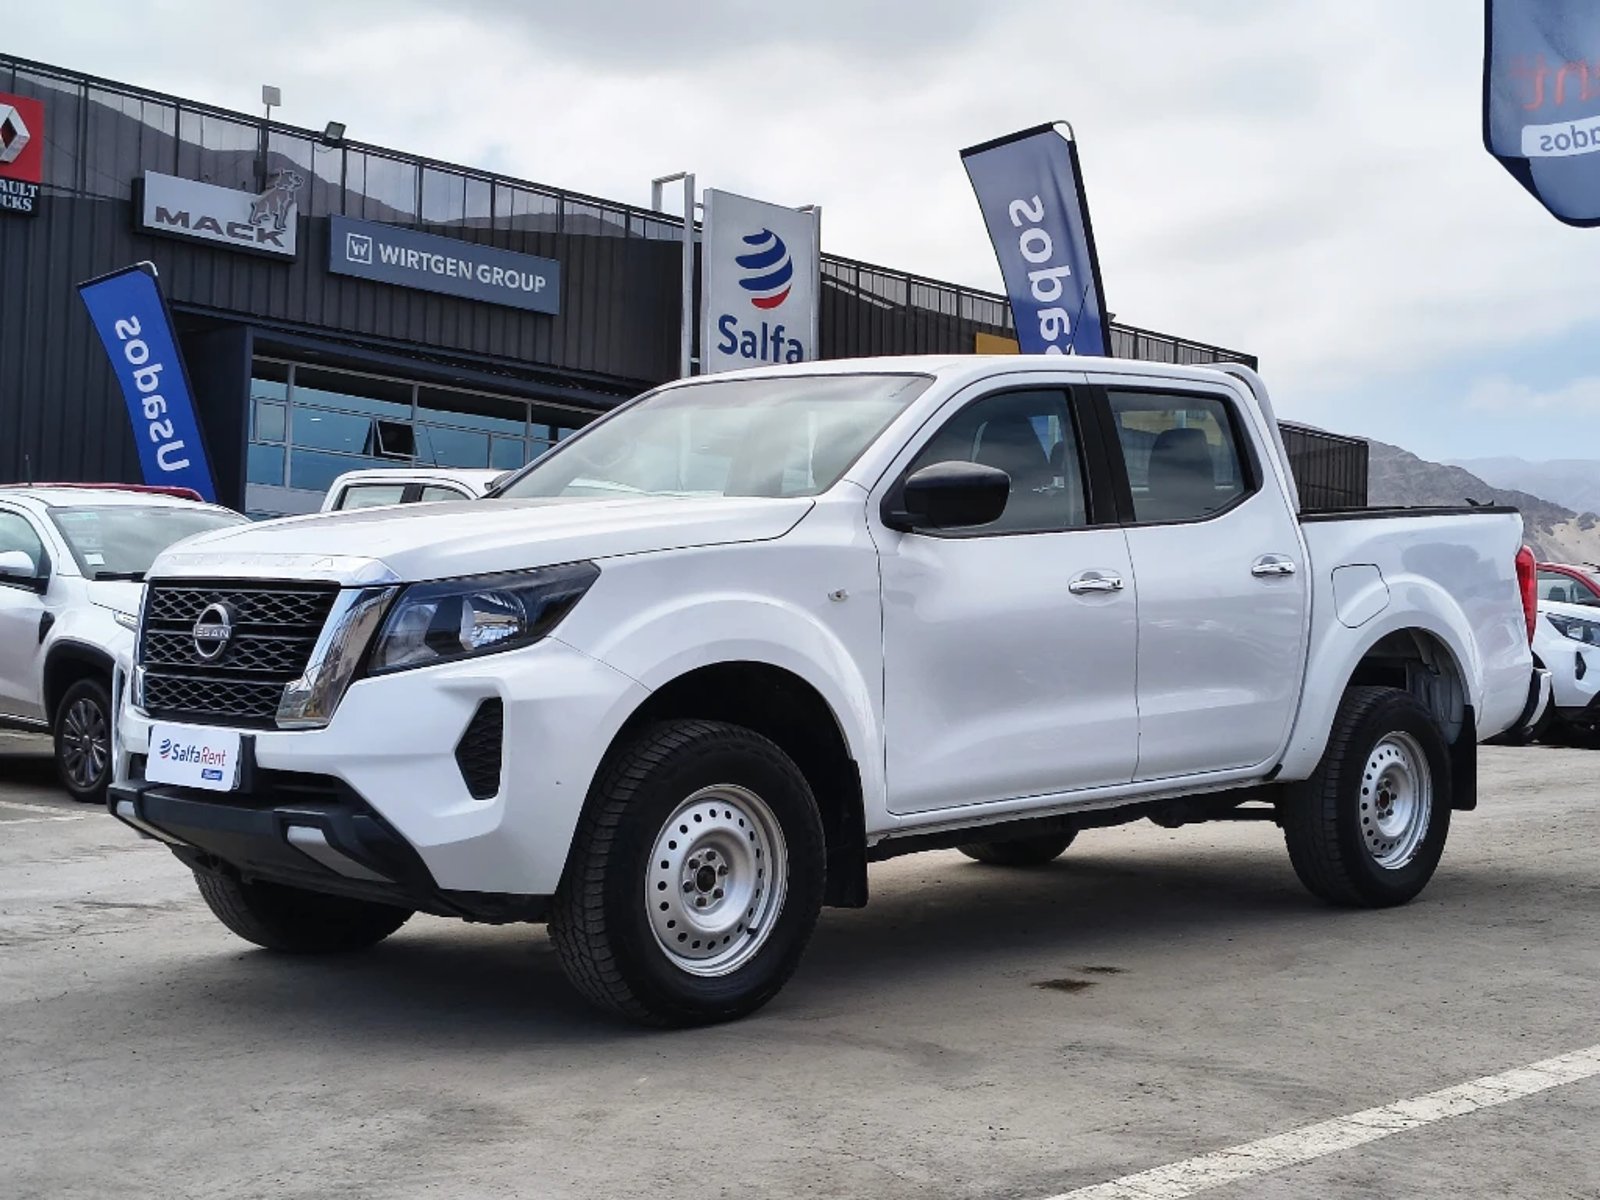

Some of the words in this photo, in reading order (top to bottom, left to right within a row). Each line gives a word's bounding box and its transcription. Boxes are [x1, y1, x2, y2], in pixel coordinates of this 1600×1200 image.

[0, 193, 32, 212] CKS
[155, 206, 285, 248] MACK
[378, 242, 473, 280] WIRTGEN
[476, 264, 546, 293] GROUP
[717, 314, 804, 365] Salfa
